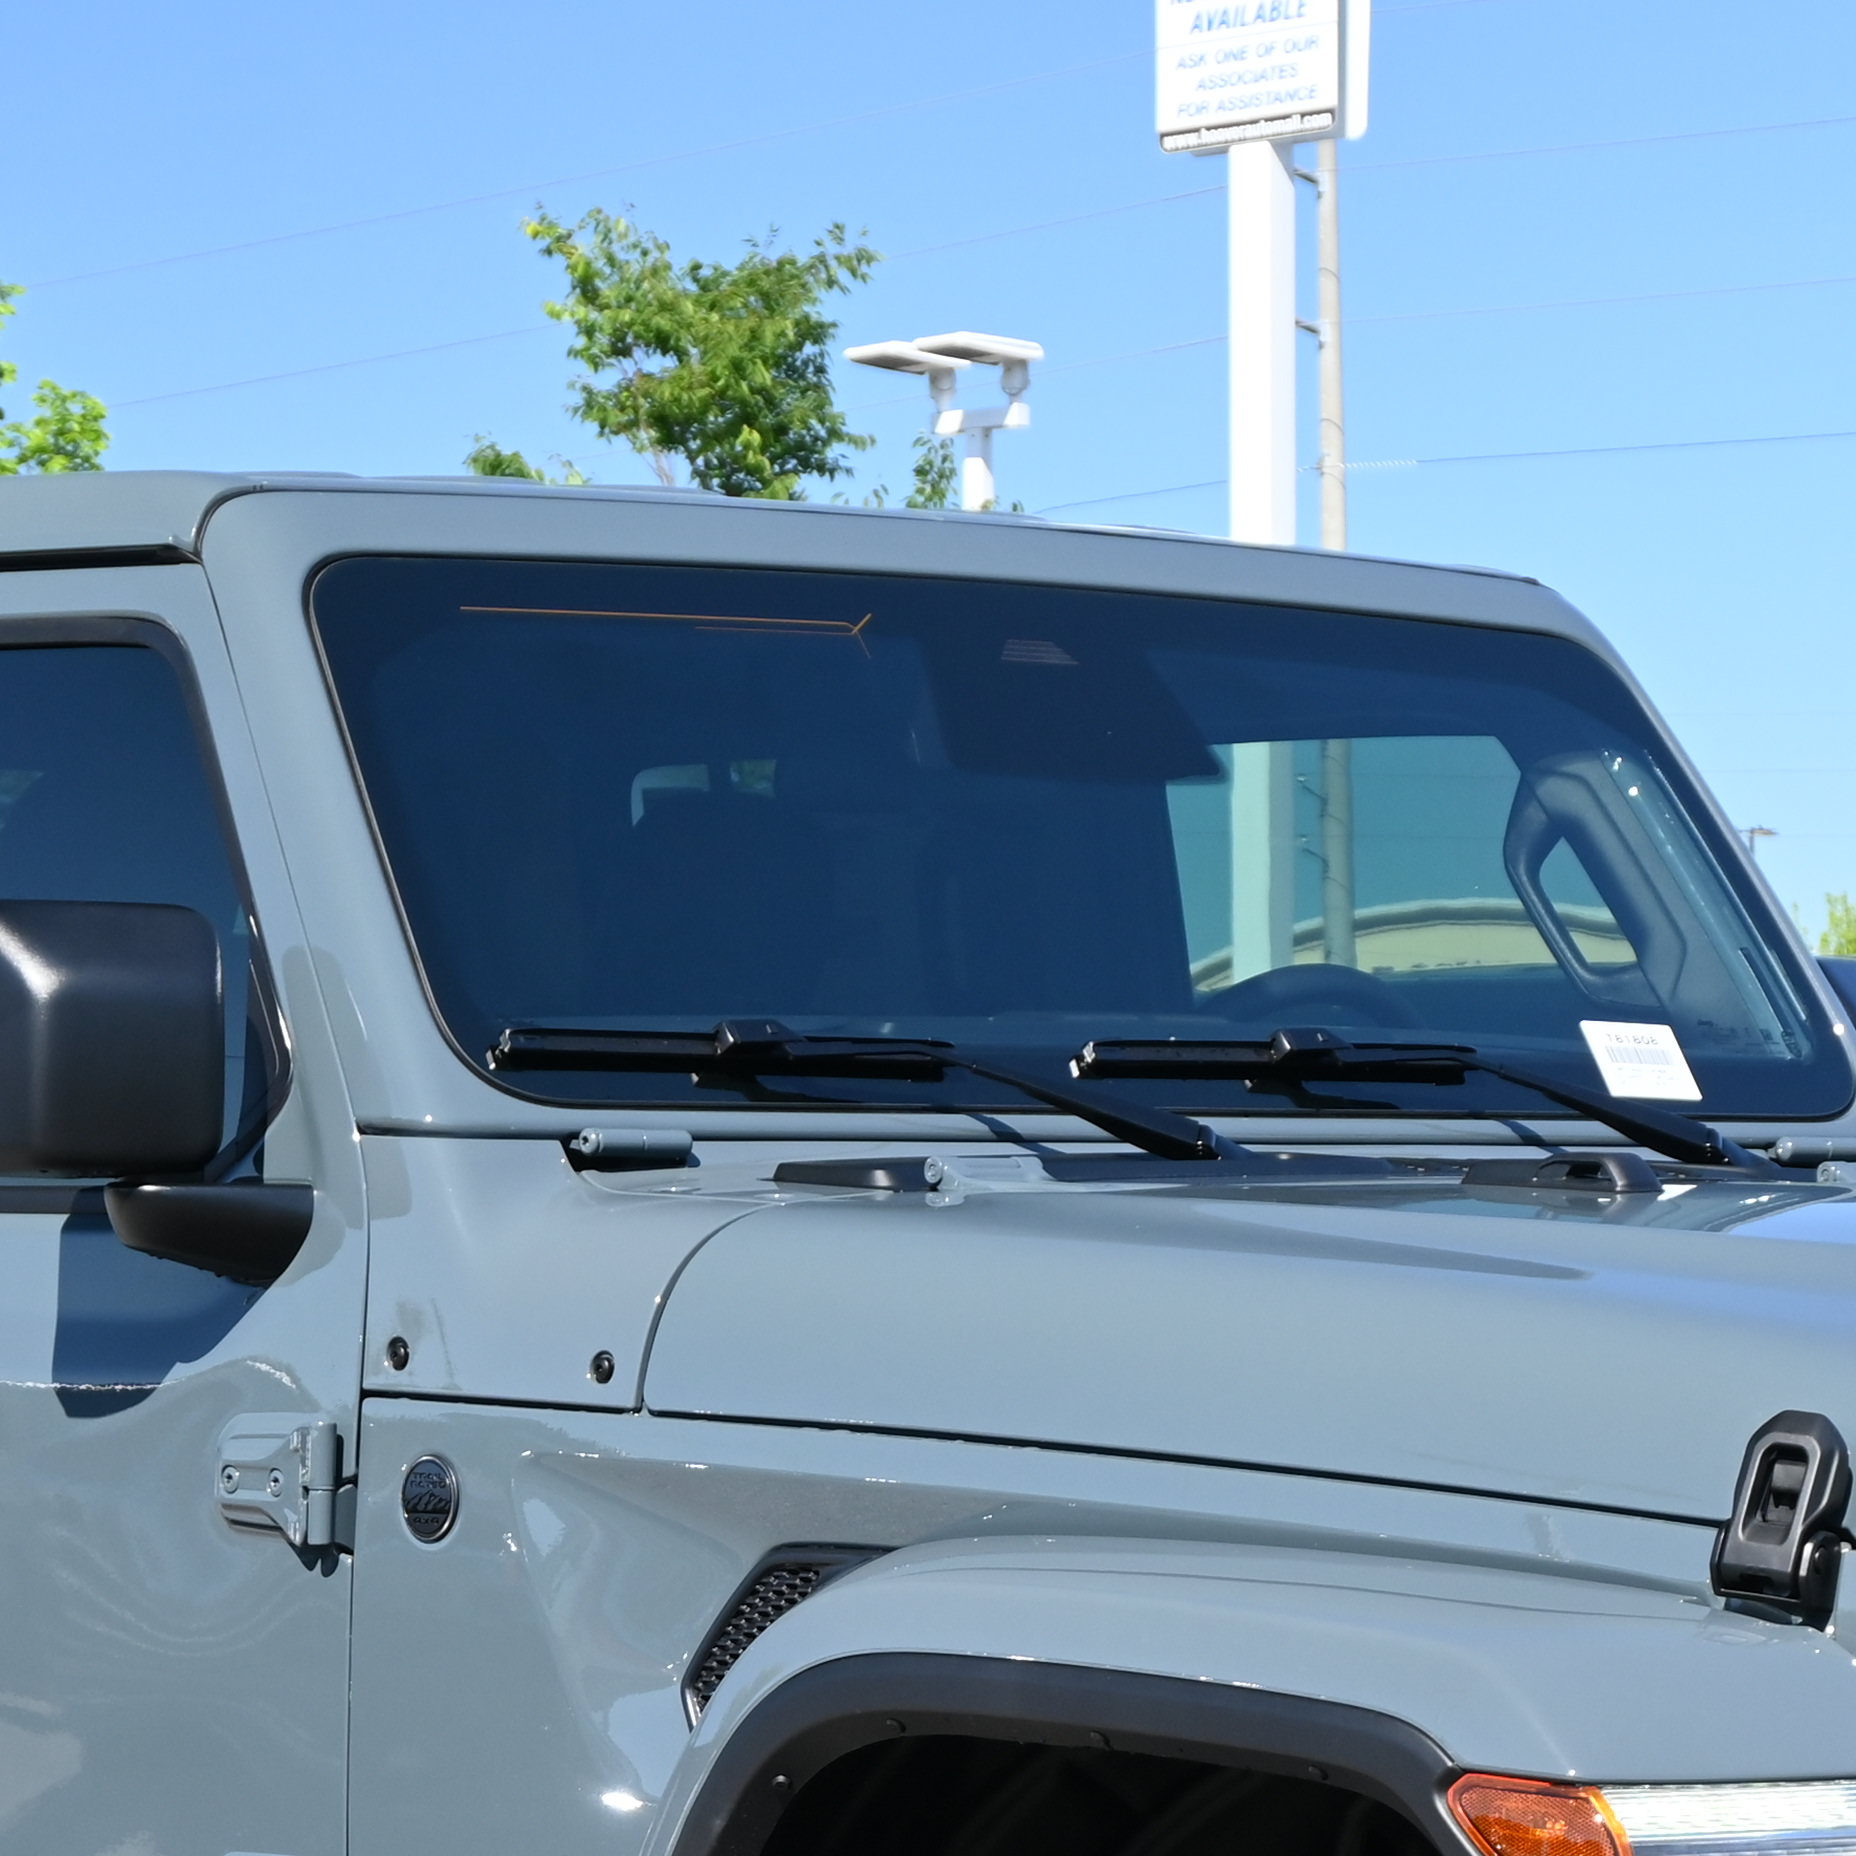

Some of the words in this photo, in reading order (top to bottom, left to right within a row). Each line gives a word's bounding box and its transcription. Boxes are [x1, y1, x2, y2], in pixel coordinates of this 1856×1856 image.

[1190, 0, 1307, 34] AVAILABLE
[1176, 52, 1207, 70] ASK
[1215, 47, 1248, 64] ONE
[1255, 40, 1277, 58] OF
[1283, 35, 1319, 54] OUR
[1196, 63, 1298, 91] ASSOCIATES
[1176, 101, 1209, 119] FOR
[1216, 85, 1318, 113] ASSISTANCE
